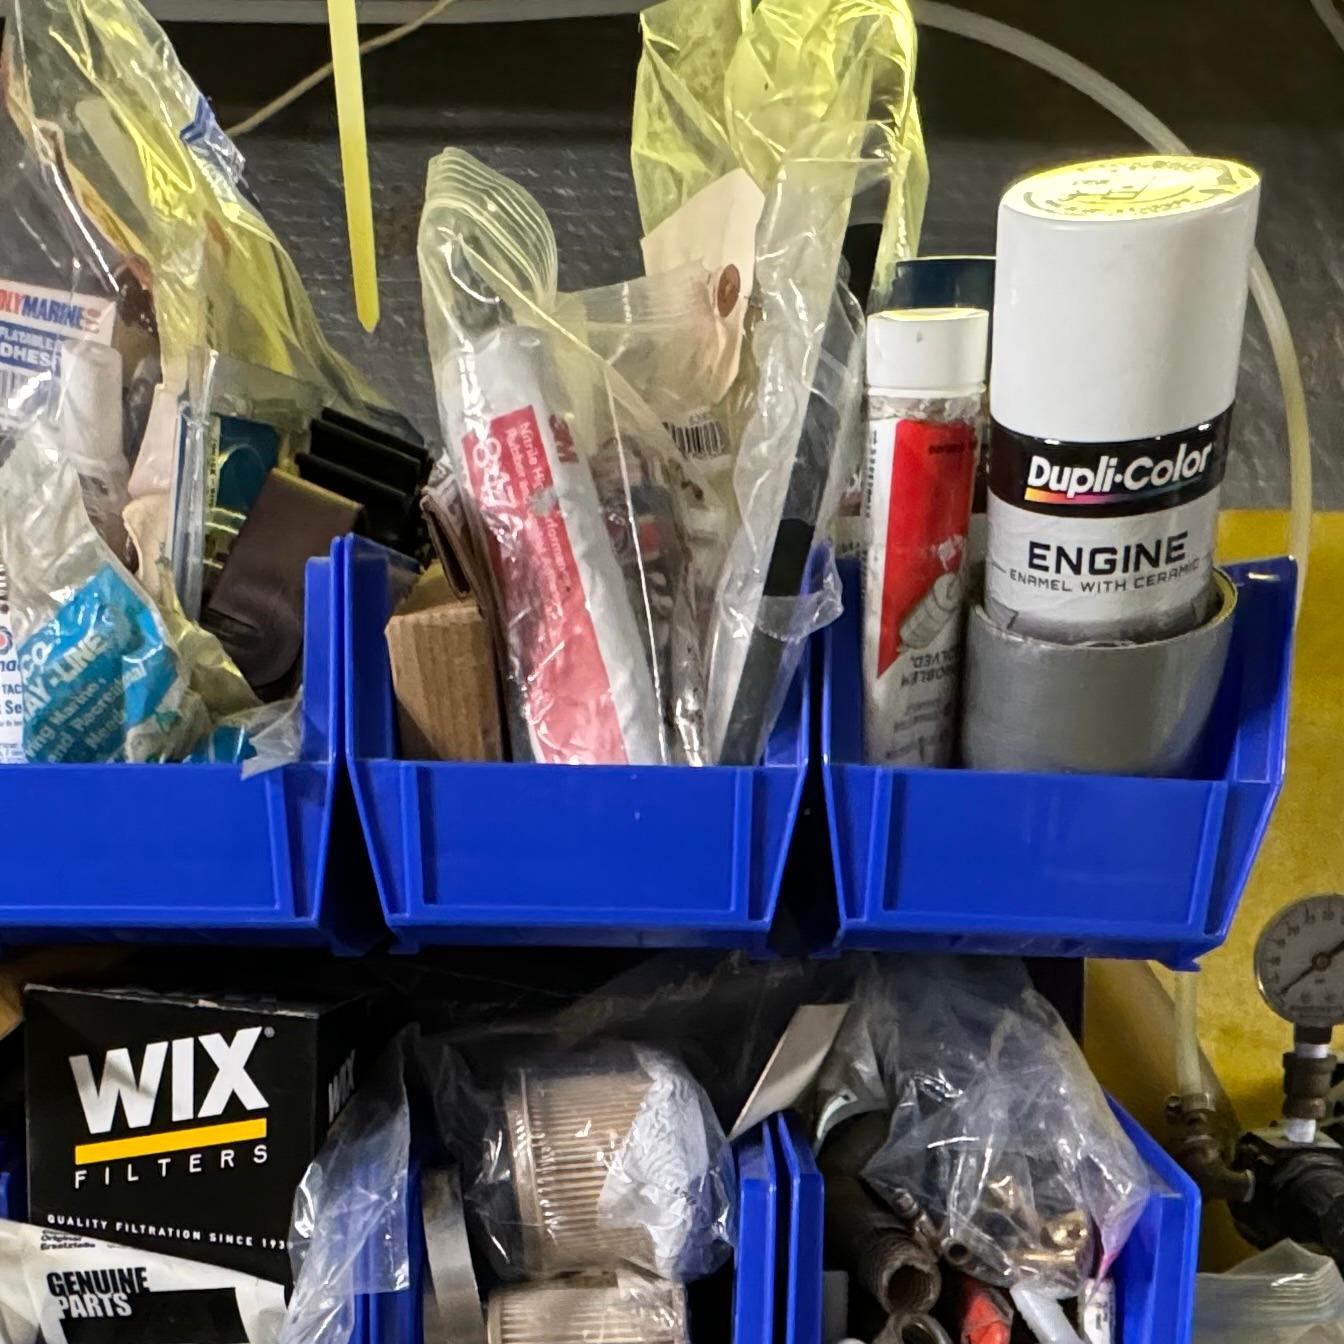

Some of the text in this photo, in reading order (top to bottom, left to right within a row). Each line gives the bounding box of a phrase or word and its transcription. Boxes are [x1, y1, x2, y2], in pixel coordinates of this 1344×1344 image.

[548, 414, 580, 463] 3M
[1027, 529, 1189, 576] ENGINE
[1009, 558, 1200, 593] ENAMEL WITH CERAMIC
[1, 682, 23, 696] TAC
[24, 633, 105, 721] AY-LINE
[4, 698, 23, 716] Se
[27, 724, 56, 758] ving
[68, 1026, 270, 1135] WIX
[74, 1144, 268, 1189] FILTERS
[47, 1213, 108, 1230] QUALITY
[115, 1221, 202, 1241] FILTRATION
[209, 1232, 253, 1248] SINCE
[46, 1266, 151, 1297] GENUINE
[58, 1292, 133, 1320] PARTS
